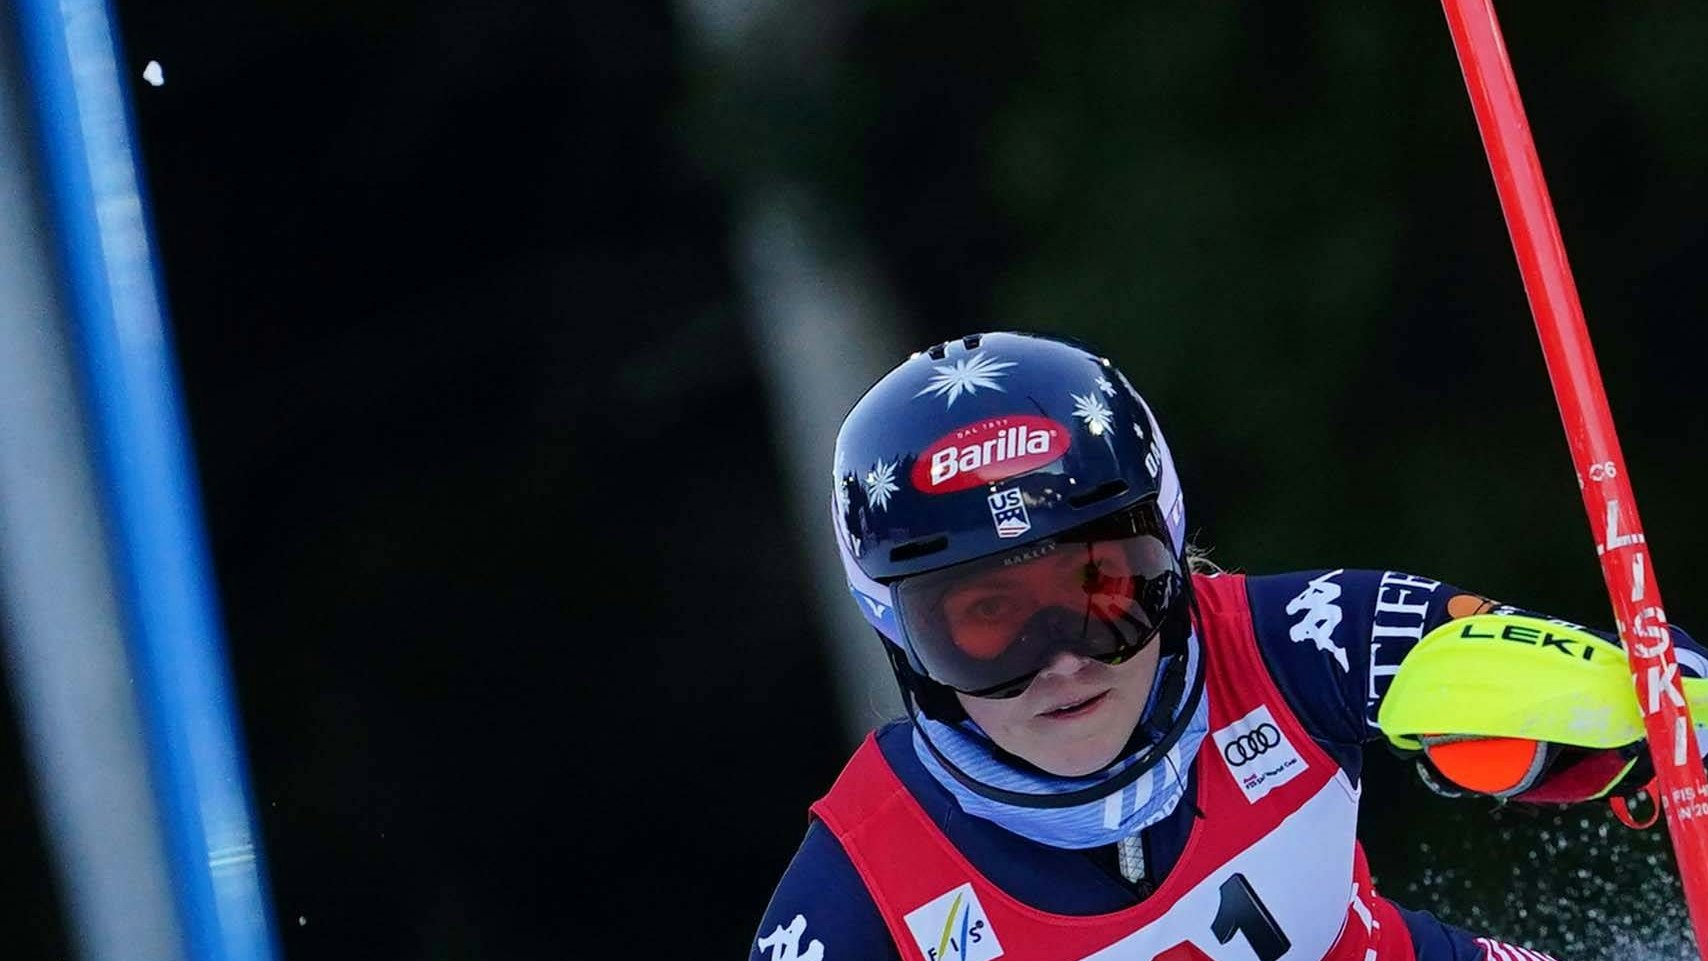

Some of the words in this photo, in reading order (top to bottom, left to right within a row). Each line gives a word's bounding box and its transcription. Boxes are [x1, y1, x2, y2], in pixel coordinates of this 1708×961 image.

[930, 425, 1051, 487] Barilla
[990, 490, 1021, 511] US
[1366, 570, 1442, 730] TIFE
[1459, 623, 1595, 662] LEKI
